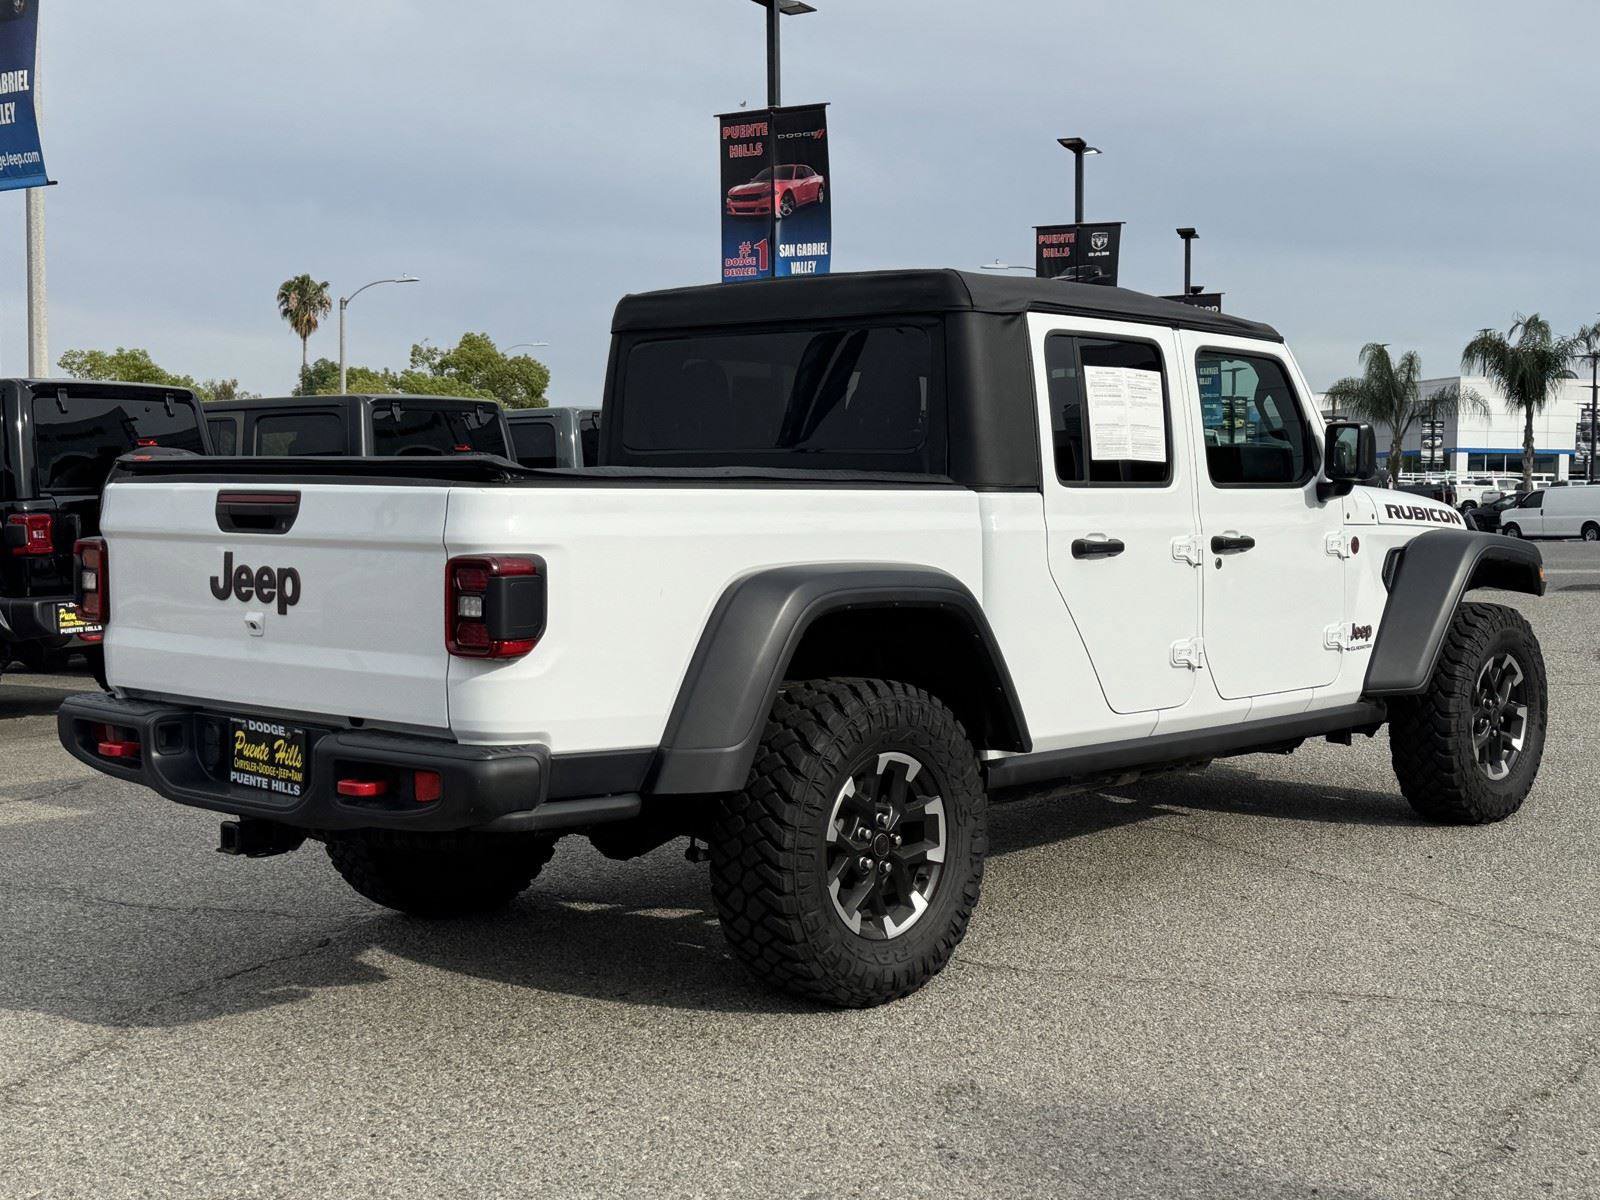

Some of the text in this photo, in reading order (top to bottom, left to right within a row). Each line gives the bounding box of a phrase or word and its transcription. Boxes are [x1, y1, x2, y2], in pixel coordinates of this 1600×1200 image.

[722, 122, 769, 140] PUENTE
[729, 142, 764, 158] HILLS
[1038, 233, 1075, 245] PUENTE
[779, 242, 828, 258] SAN GABRIEL
[1042, 247, 1070, 258] HILLS
[725, 256, 756, 267] DODGE
[790, 260, 817, 275] VALLEY
[724, 266, 757, 277] DEALER
[1384, 503, 1461, 525] RUBICON
[209, 551, 301, 615] Jeep
[1350, 623, 1372, 641] Jeep
[248, 720, 286, 736] DODGE
[234, 730, 303, 769] Puente Hills
[230, 771, 301, 796] PUENTE HILLS
